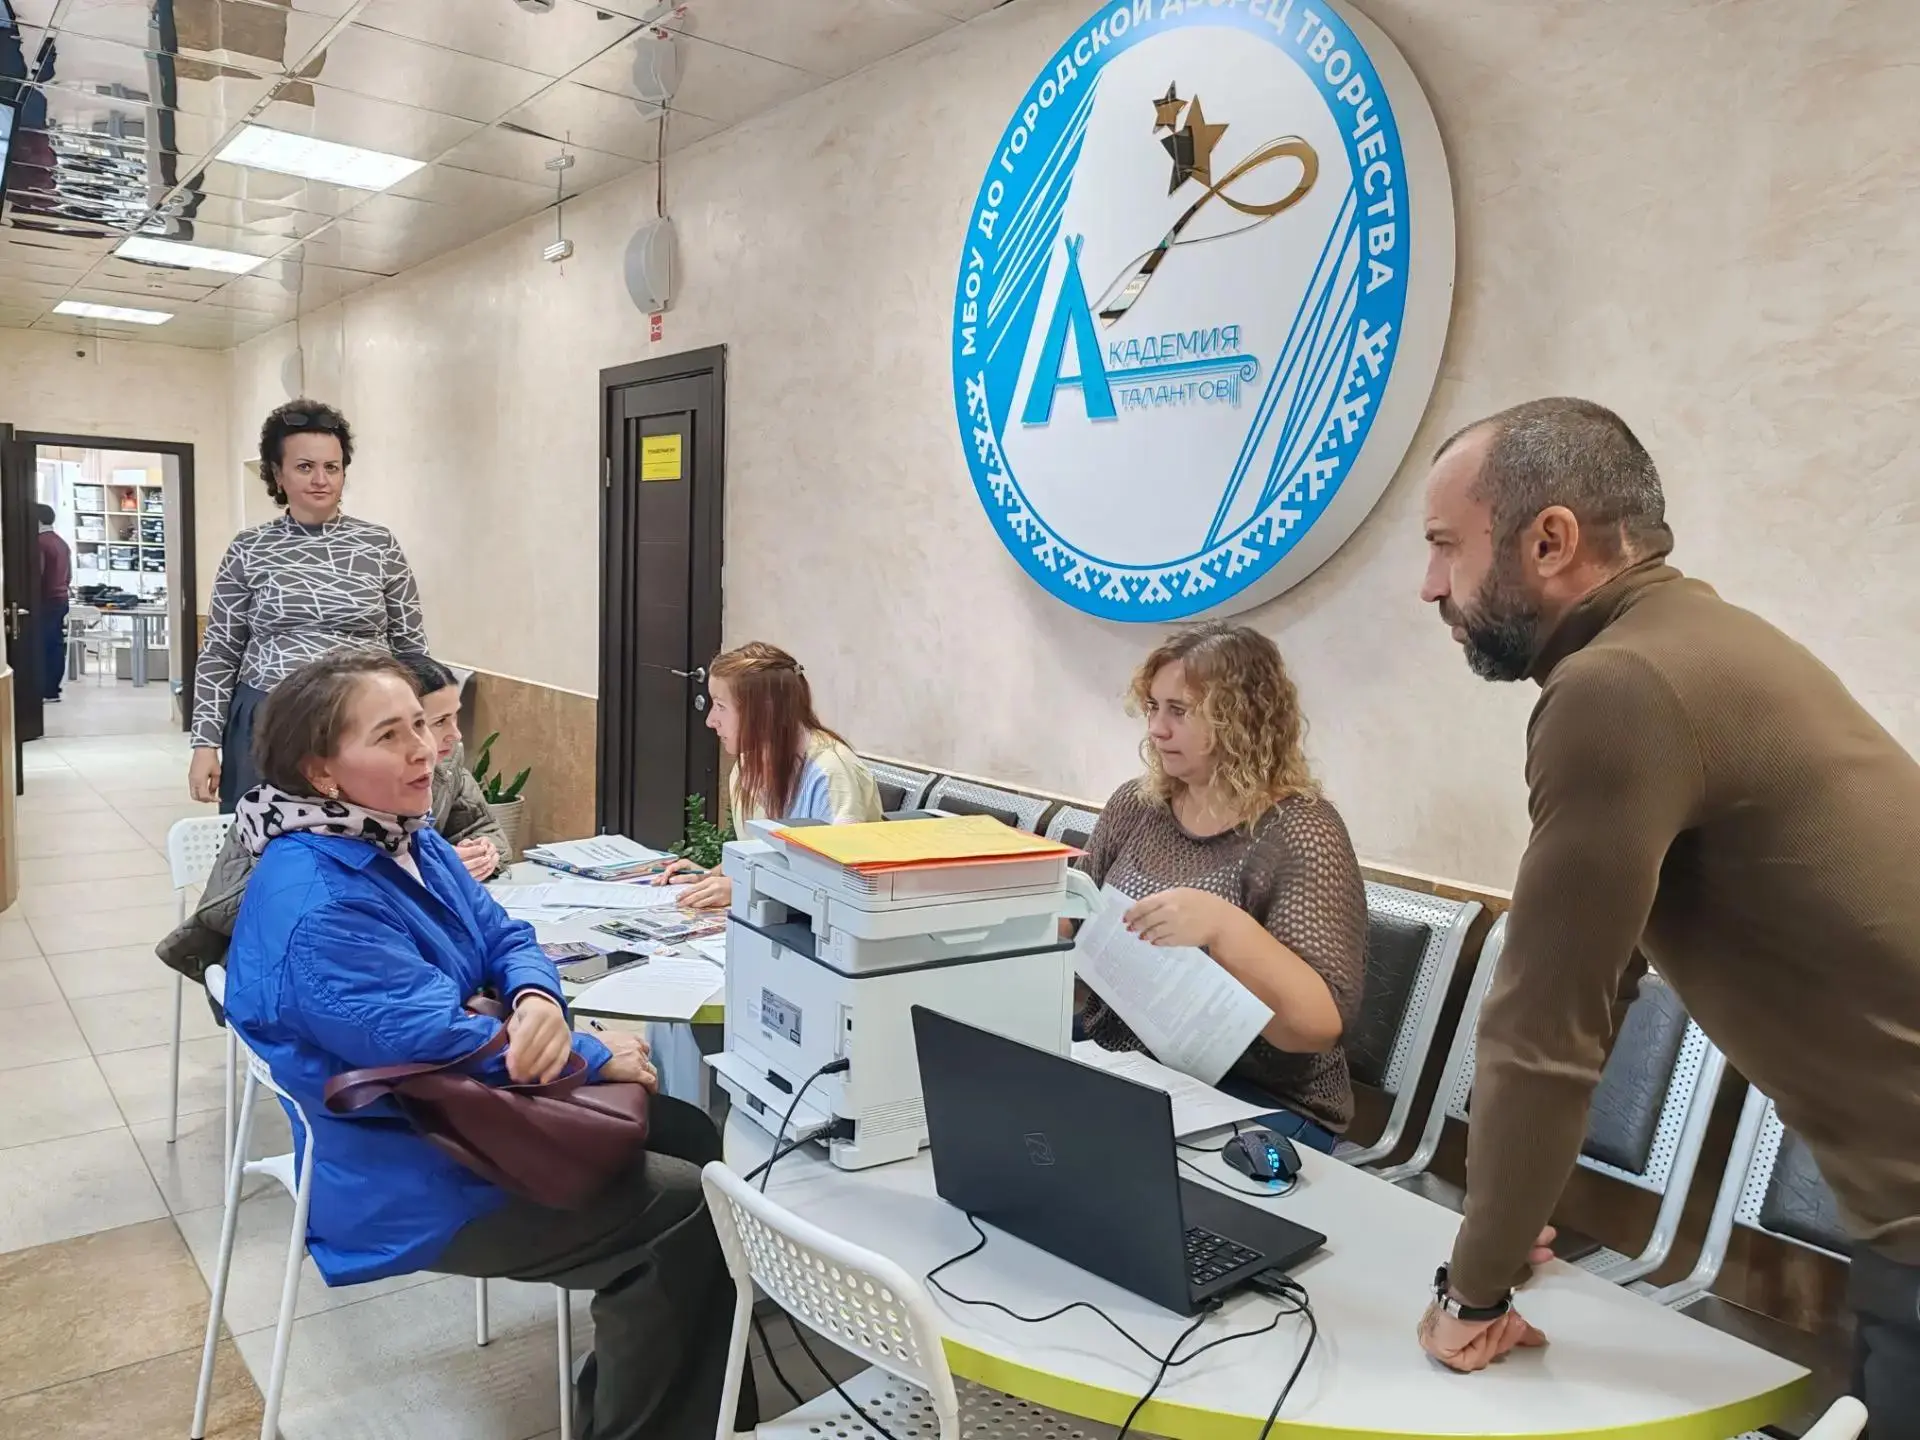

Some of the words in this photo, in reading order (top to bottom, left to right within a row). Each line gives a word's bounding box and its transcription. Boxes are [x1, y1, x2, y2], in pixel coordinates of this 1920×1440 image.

[962, 246, 984, 356] МБОУ
[978, 179, 1005, 240] ДО
[1295, 8, 1395, 294] ТВОРЧЕСТВА
[1118, 379, 1231, 407] ТАЛАНТОВ
